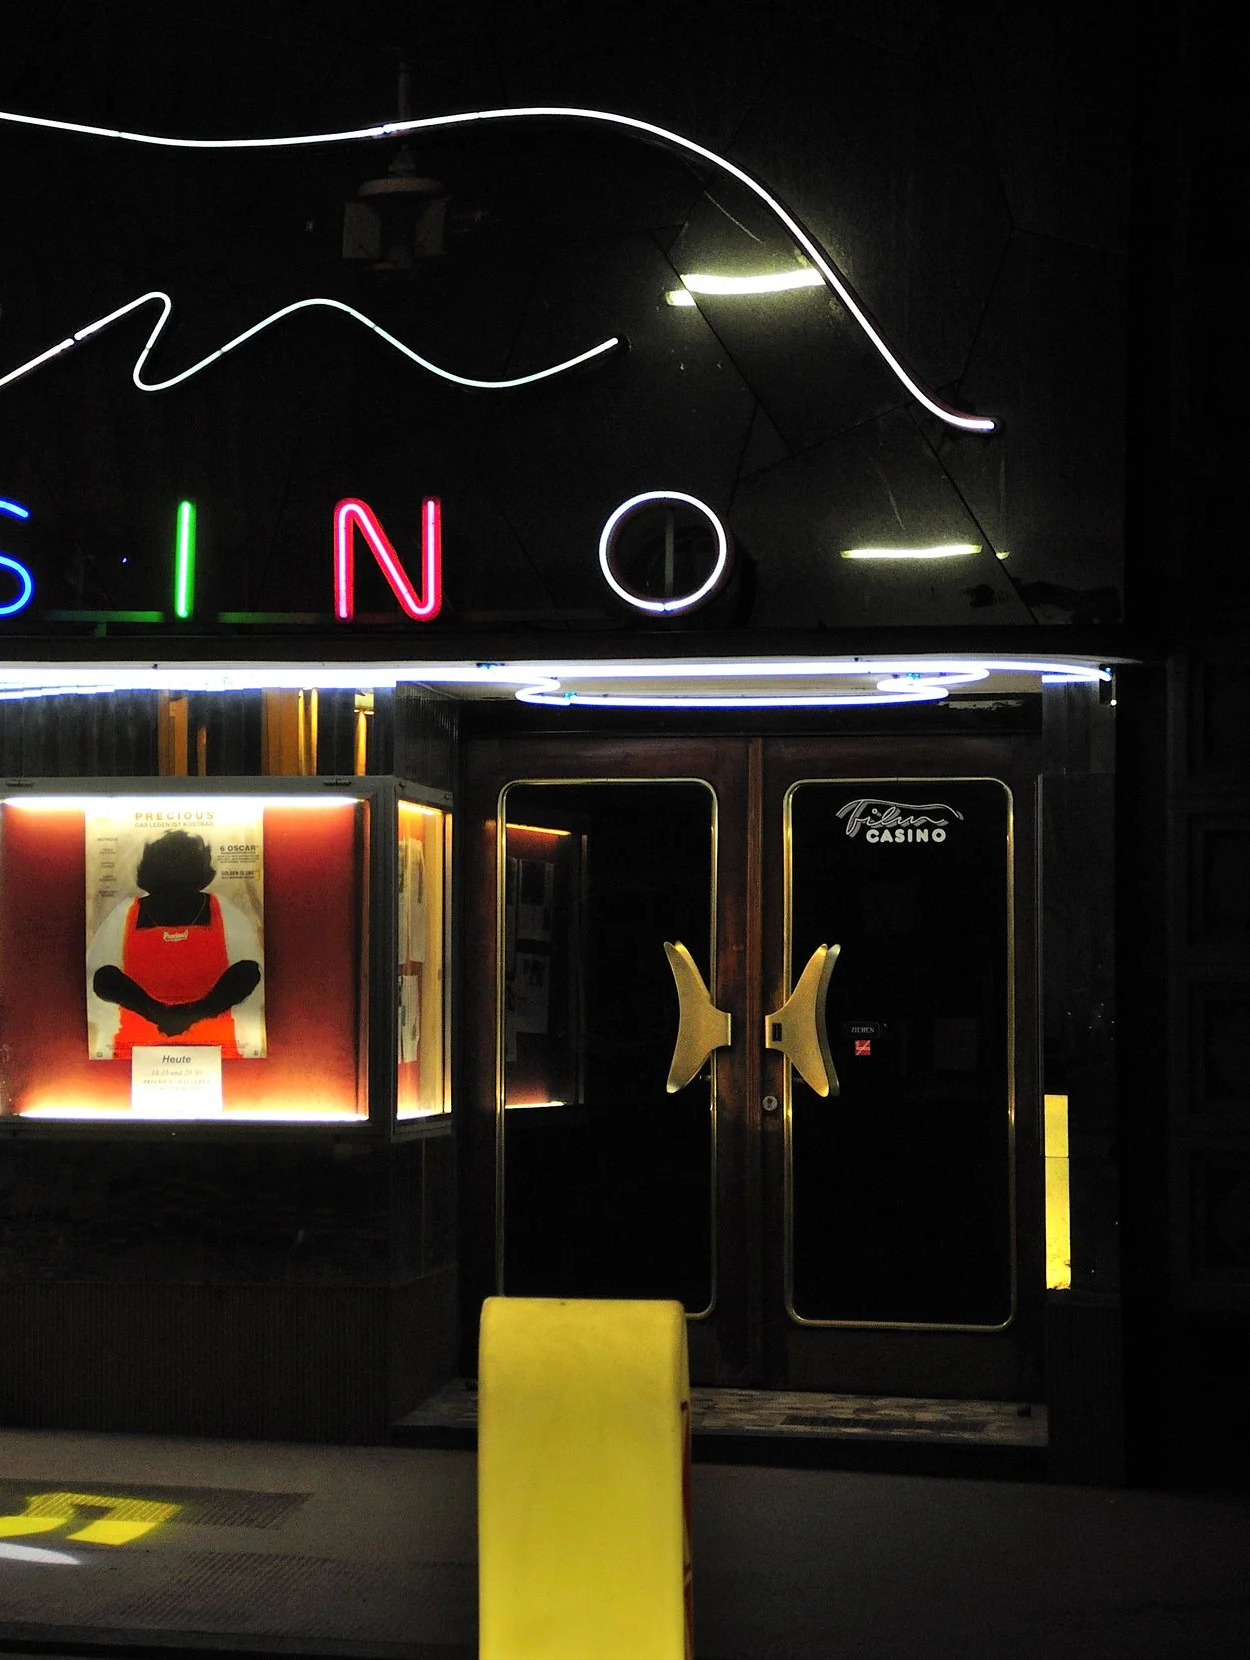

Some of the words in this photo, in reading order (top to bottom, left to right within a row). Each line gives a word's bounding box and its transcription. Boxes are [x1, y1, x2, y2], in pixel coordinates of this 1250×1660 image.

[135, 811, 214, 821] PRECIOUS
[835, 798, 964, 838] Film
[865, 828, 947, 843] CASINO
[220, 844, 225, 852] 6
[162, 1054, 192, 1065] Heute
